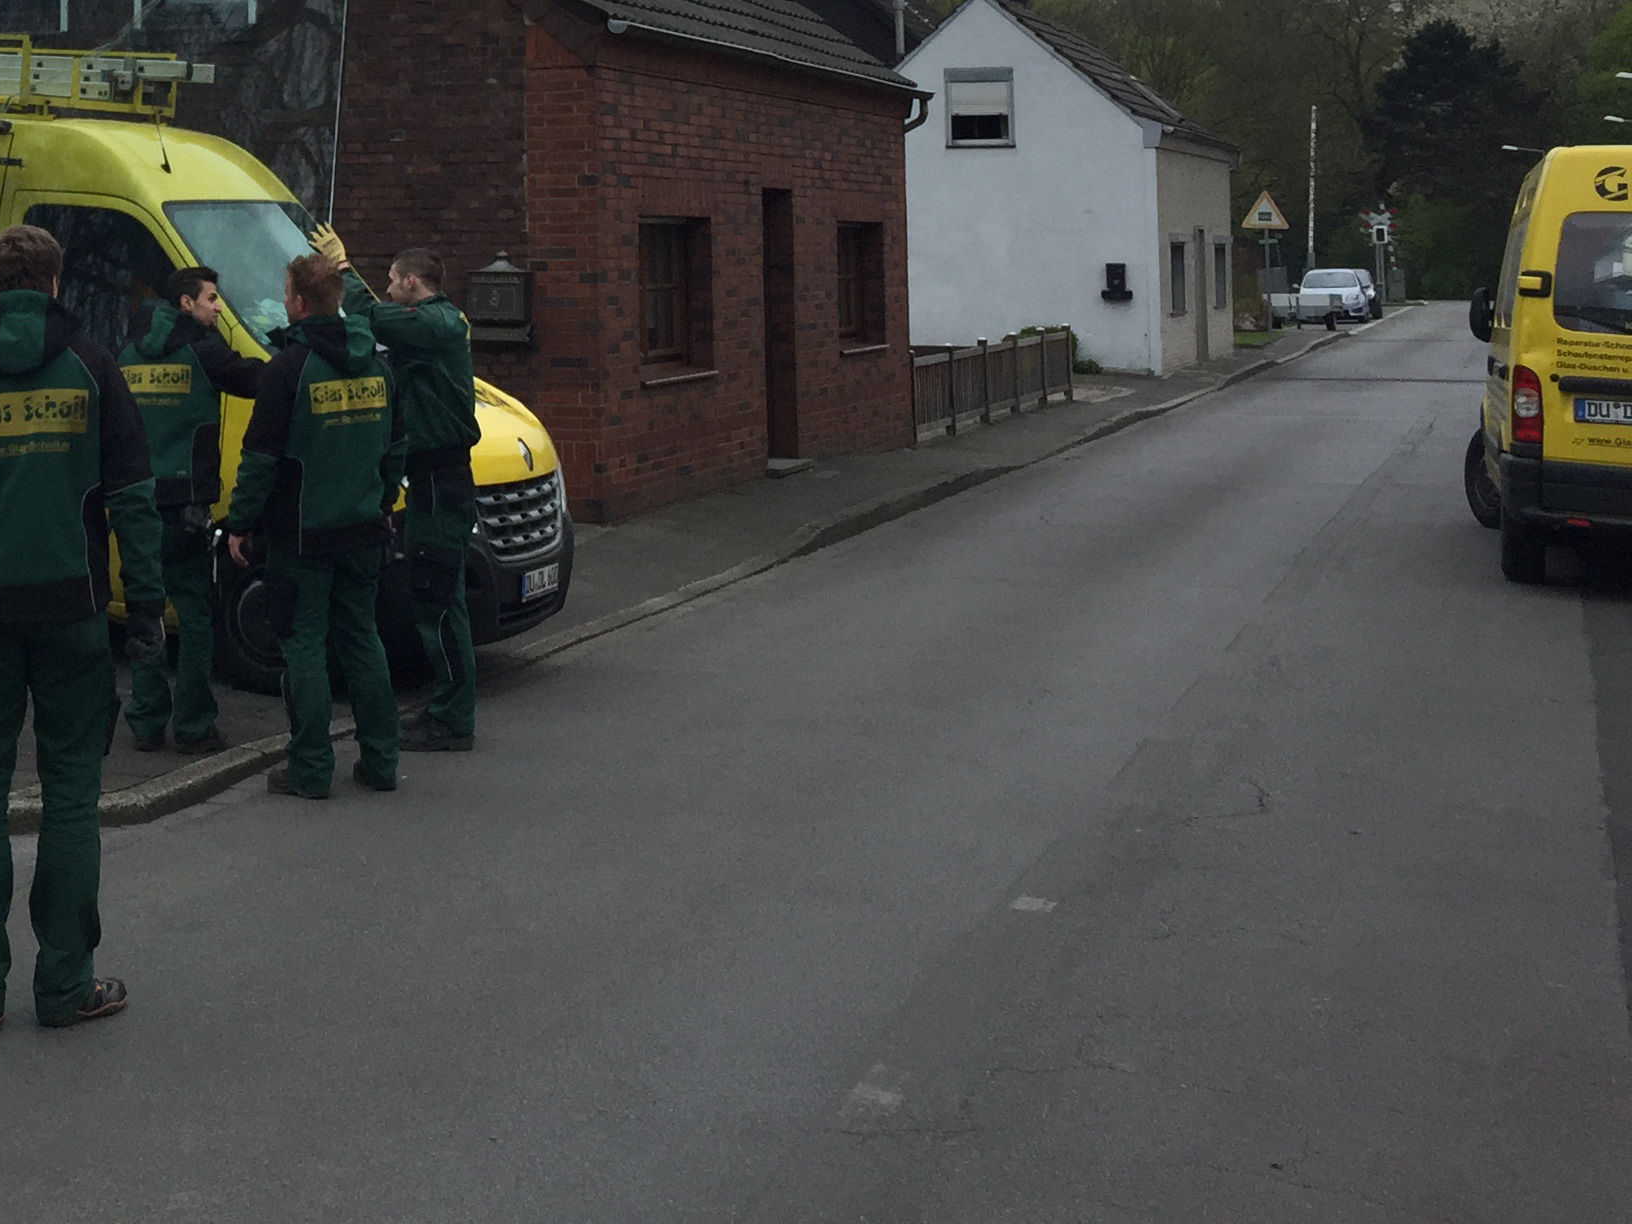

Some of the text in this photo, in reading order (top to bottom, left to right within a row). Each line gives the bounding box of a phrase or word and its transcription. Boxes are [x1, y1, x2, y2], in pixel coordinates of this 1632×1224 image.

[149, 367, 190, 385] Scholl
[312, 380, 385, 404] Glas Scholl
[23, 395, 87, 422] Scholl
[1587, 401, 1611, 418] DU
